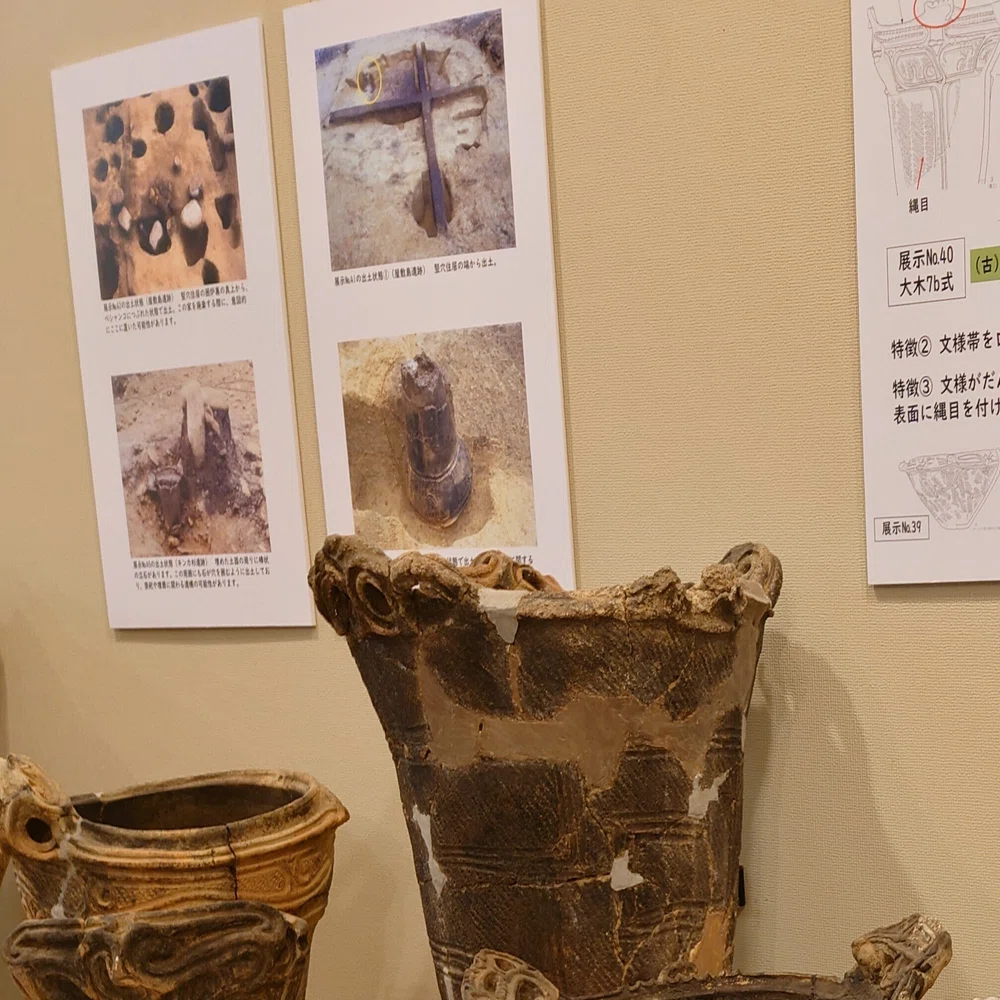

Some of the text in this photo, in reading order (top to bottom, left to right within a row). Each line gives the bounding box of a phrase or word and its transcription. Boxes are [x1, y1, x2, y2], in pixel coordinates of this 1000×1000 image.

[908, 198, 929, 214] 縄目
[899, 271, 954, 298] 大木7b式
[891, 334, 932, 359] 特徴②
[892, 375, 933, 400] 特徴③
